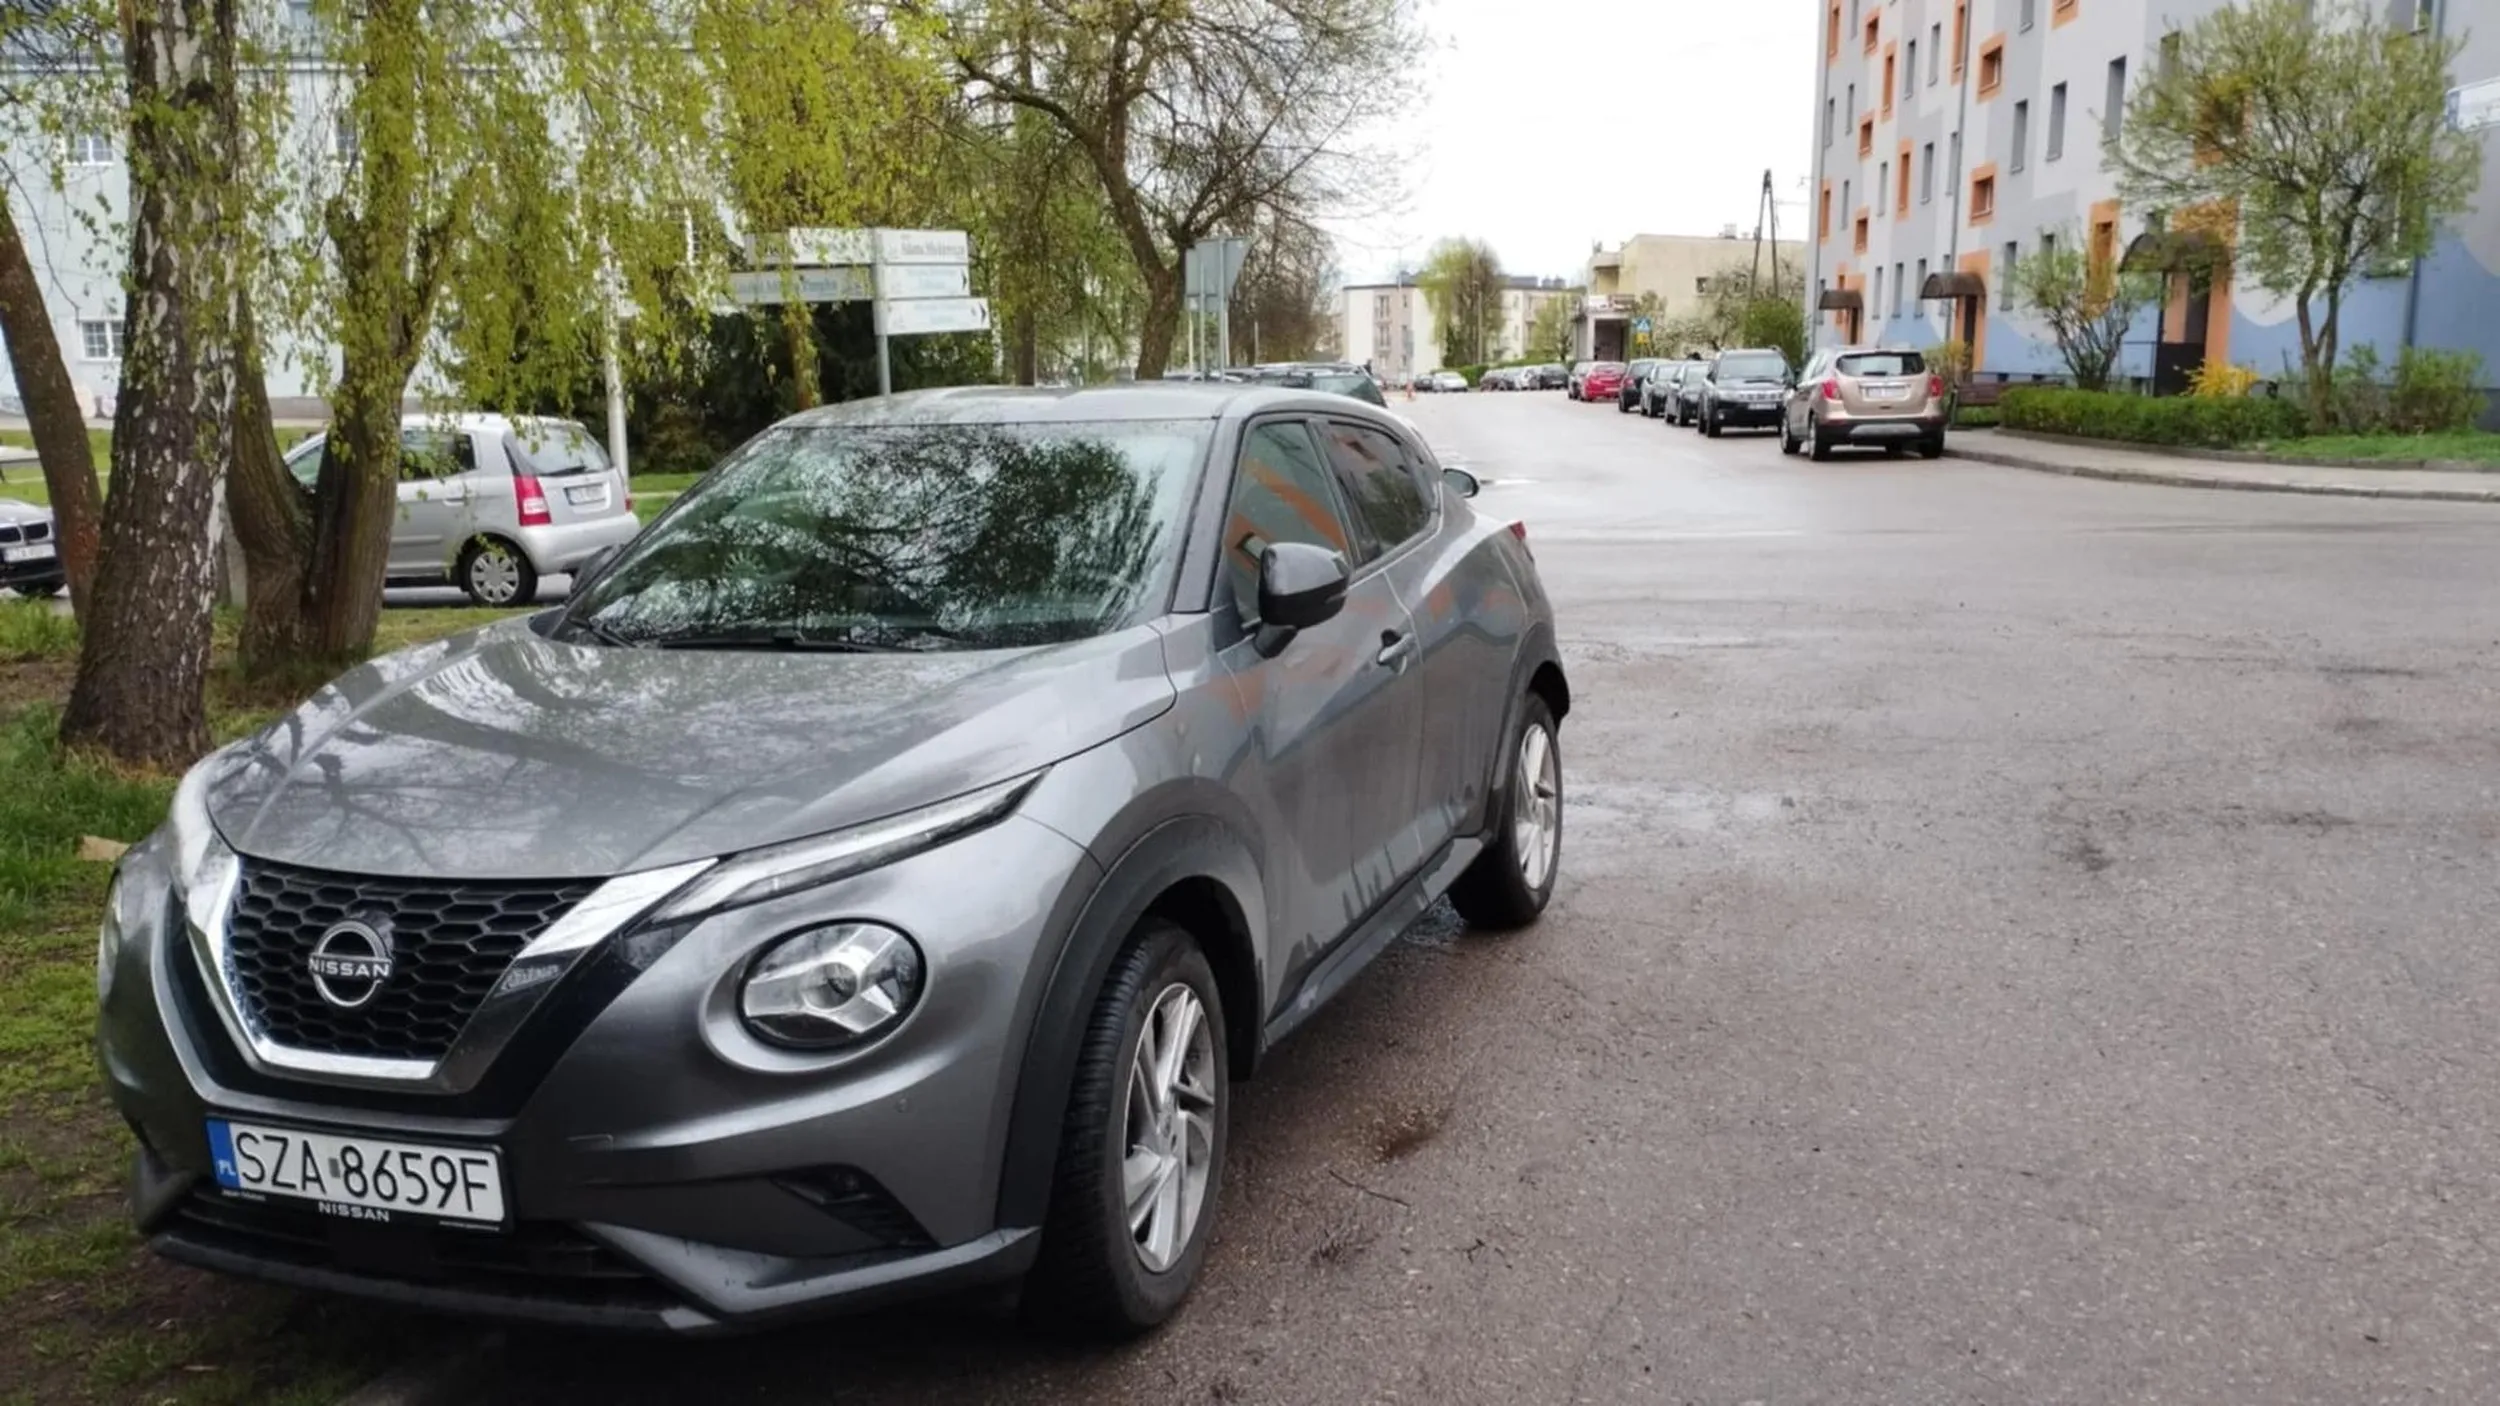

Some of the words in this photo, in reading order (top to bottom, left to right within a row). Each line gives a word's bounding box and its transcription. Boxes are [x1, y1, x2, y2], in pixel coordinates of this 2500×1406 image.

[309, 958, 390, 977] NISSAN
[216, 1159, 237, 1176] PL
[236, 1131, 327, 1194] SZA
[340, 1145, 489, 1212] 8659F
[318, 1201, 390, 1222] NISSAN
